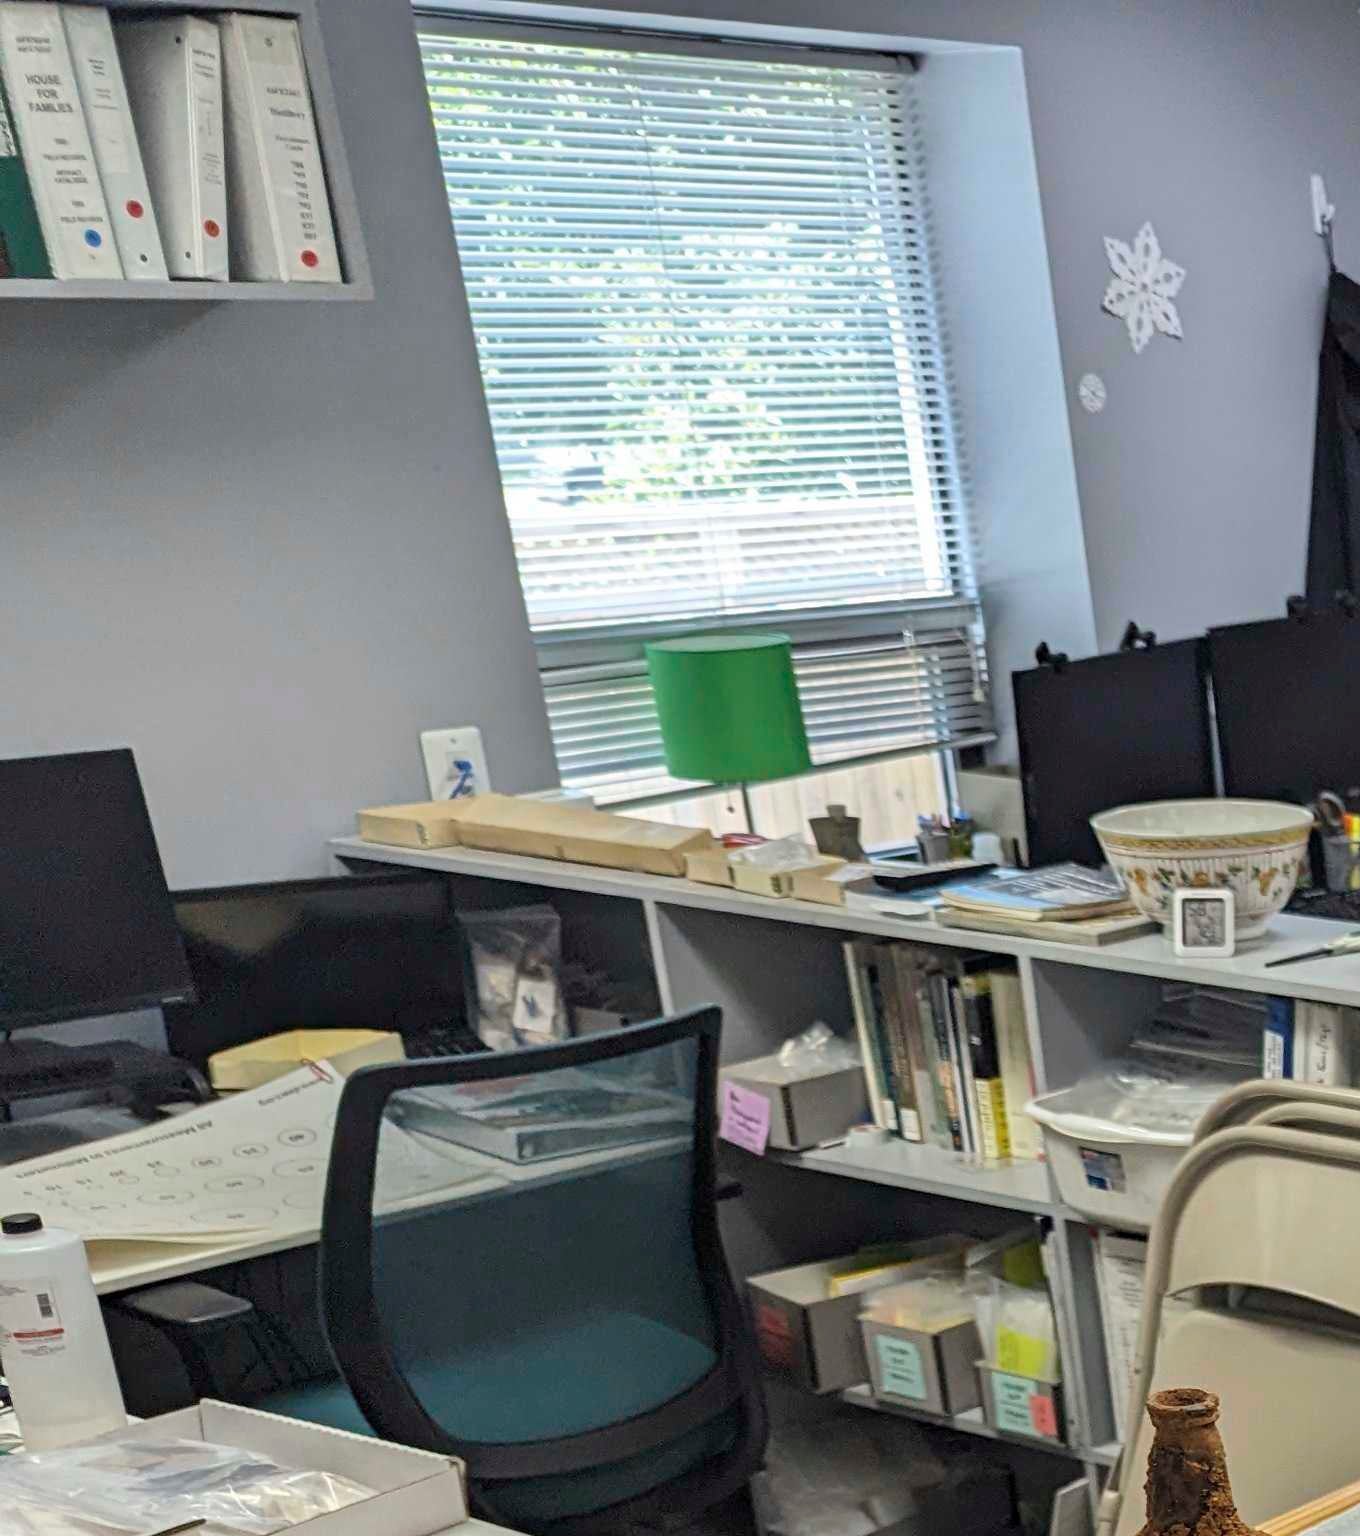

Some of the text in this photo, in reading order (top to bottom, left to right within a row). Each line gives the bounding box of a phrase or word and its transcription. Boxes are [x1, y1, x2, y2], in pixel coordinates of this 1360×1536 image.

[25, 74, 62, 86] HOUSE
[36, 89, 59, 99] FOR
[28, 102, 74, 113] FAMILIES
